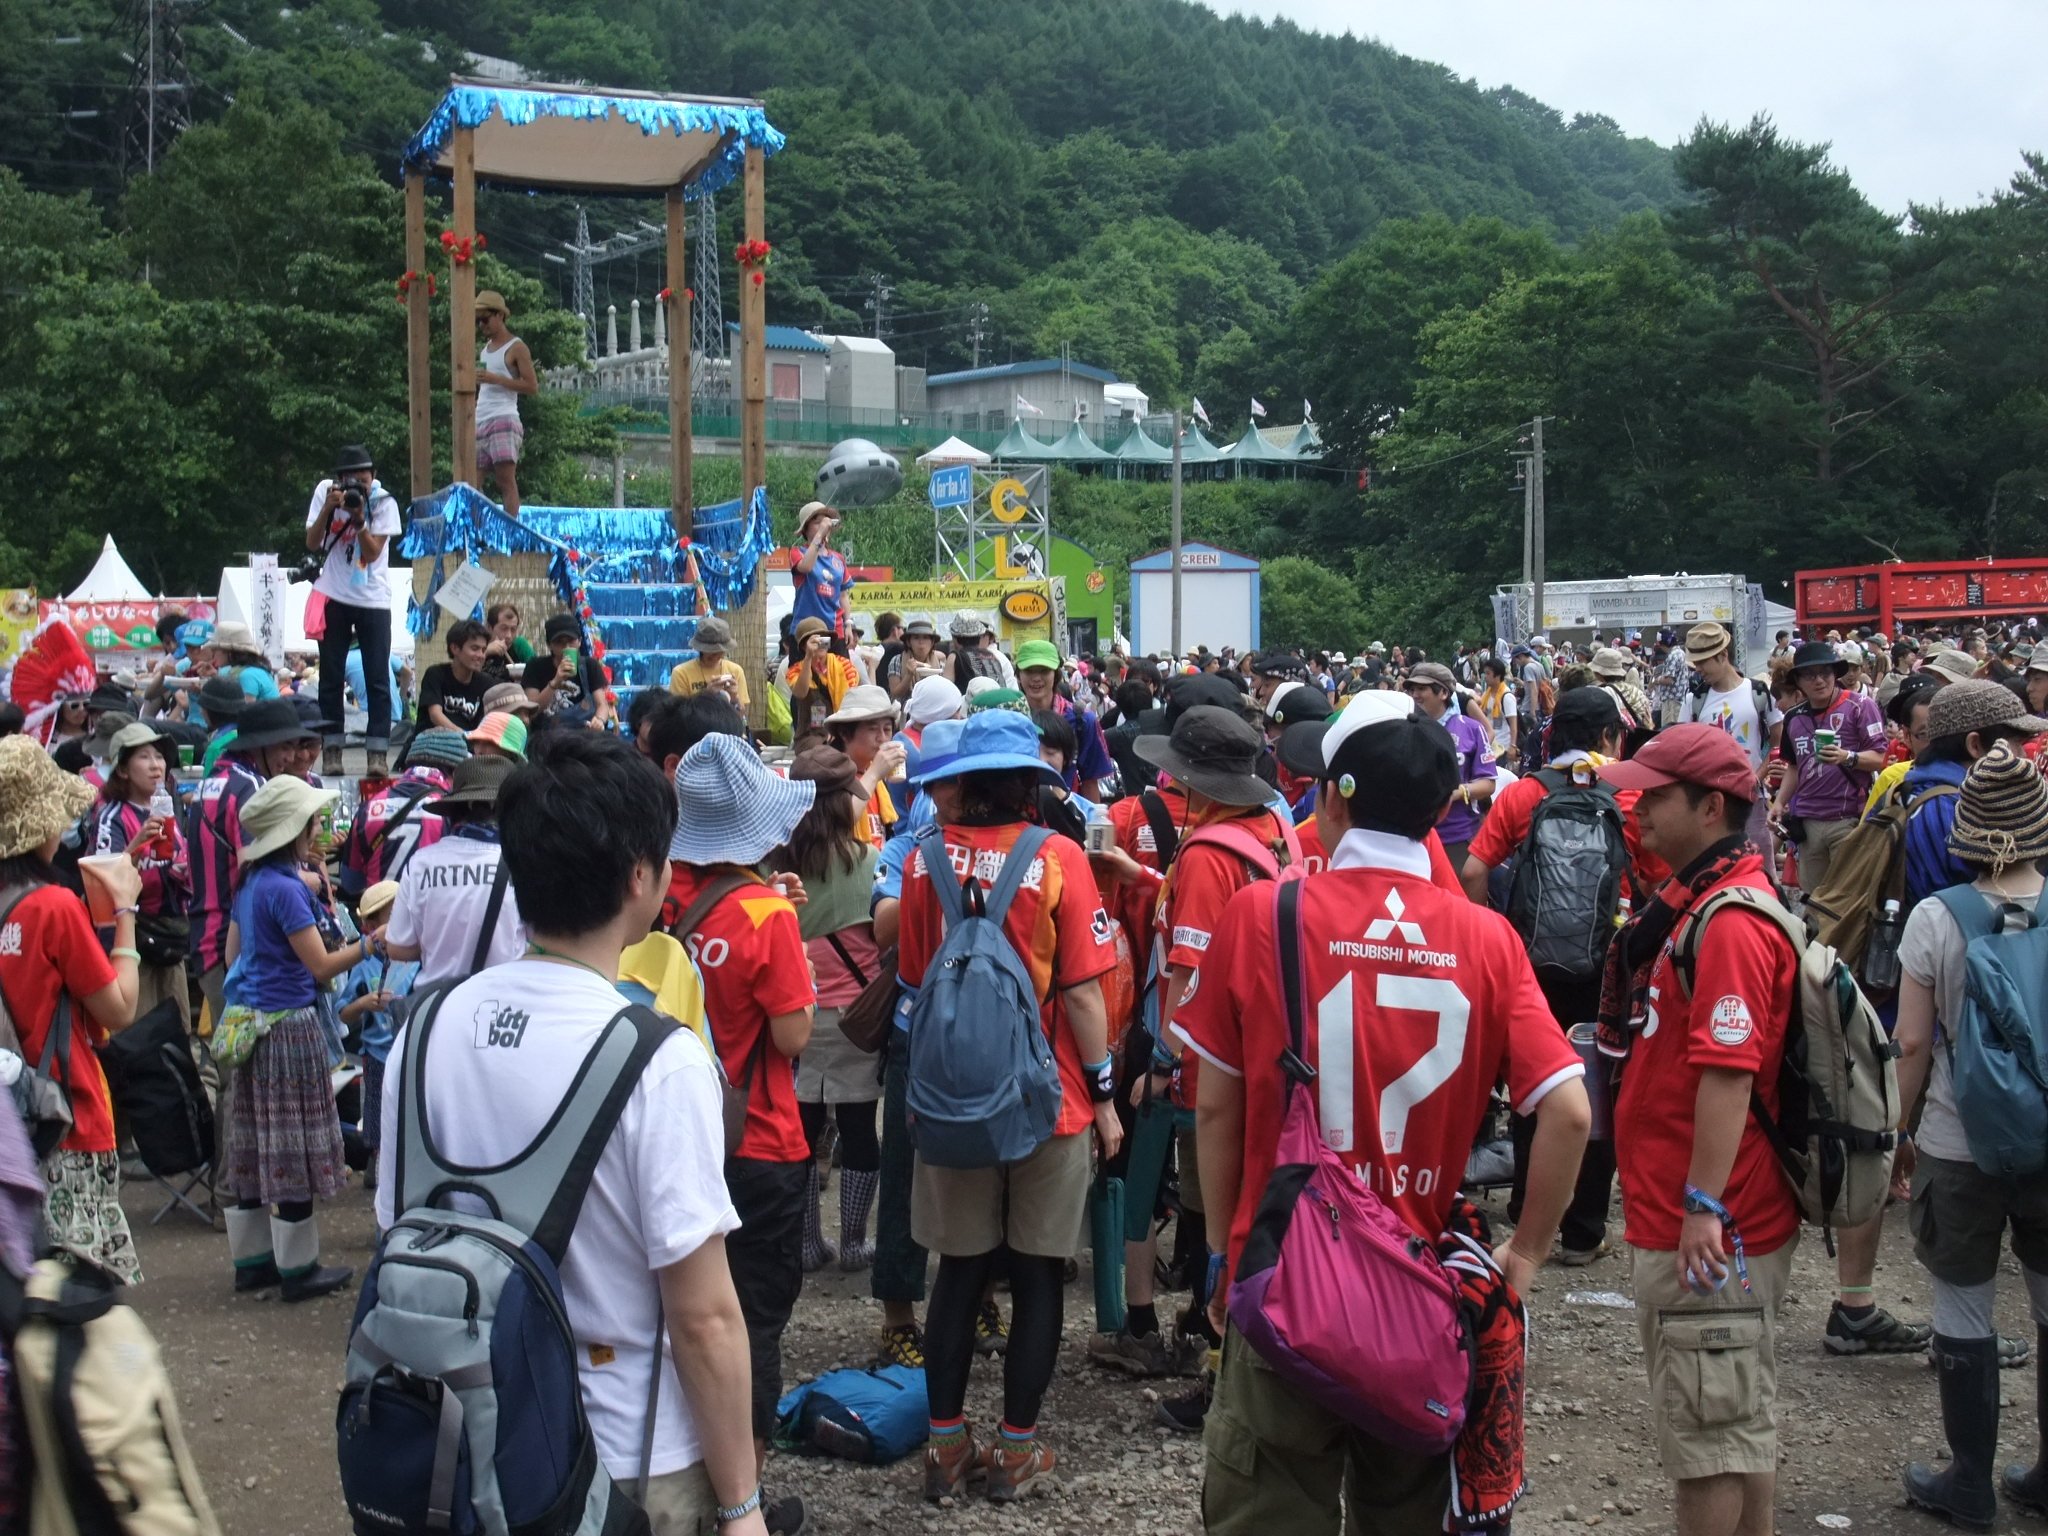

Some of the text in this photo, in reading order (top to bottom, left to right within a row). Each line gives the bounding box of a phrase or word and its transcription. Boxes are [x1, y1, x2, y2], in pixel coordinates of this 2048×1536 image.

[1180, 554, 1217, 566] CREEN
[860, 591, 894, 600] KARMA
[900, 591, 933, 600] KARMA
[939, 589, 971, 599] KARMA
[1012, 604, 1041, 613] KARMA
[420, 863, 500, 890] ARTNE
[1329, 940, 1457, 968] MITSUBISHI MOTORS
[1318, 970, 1471, 1155] 17
